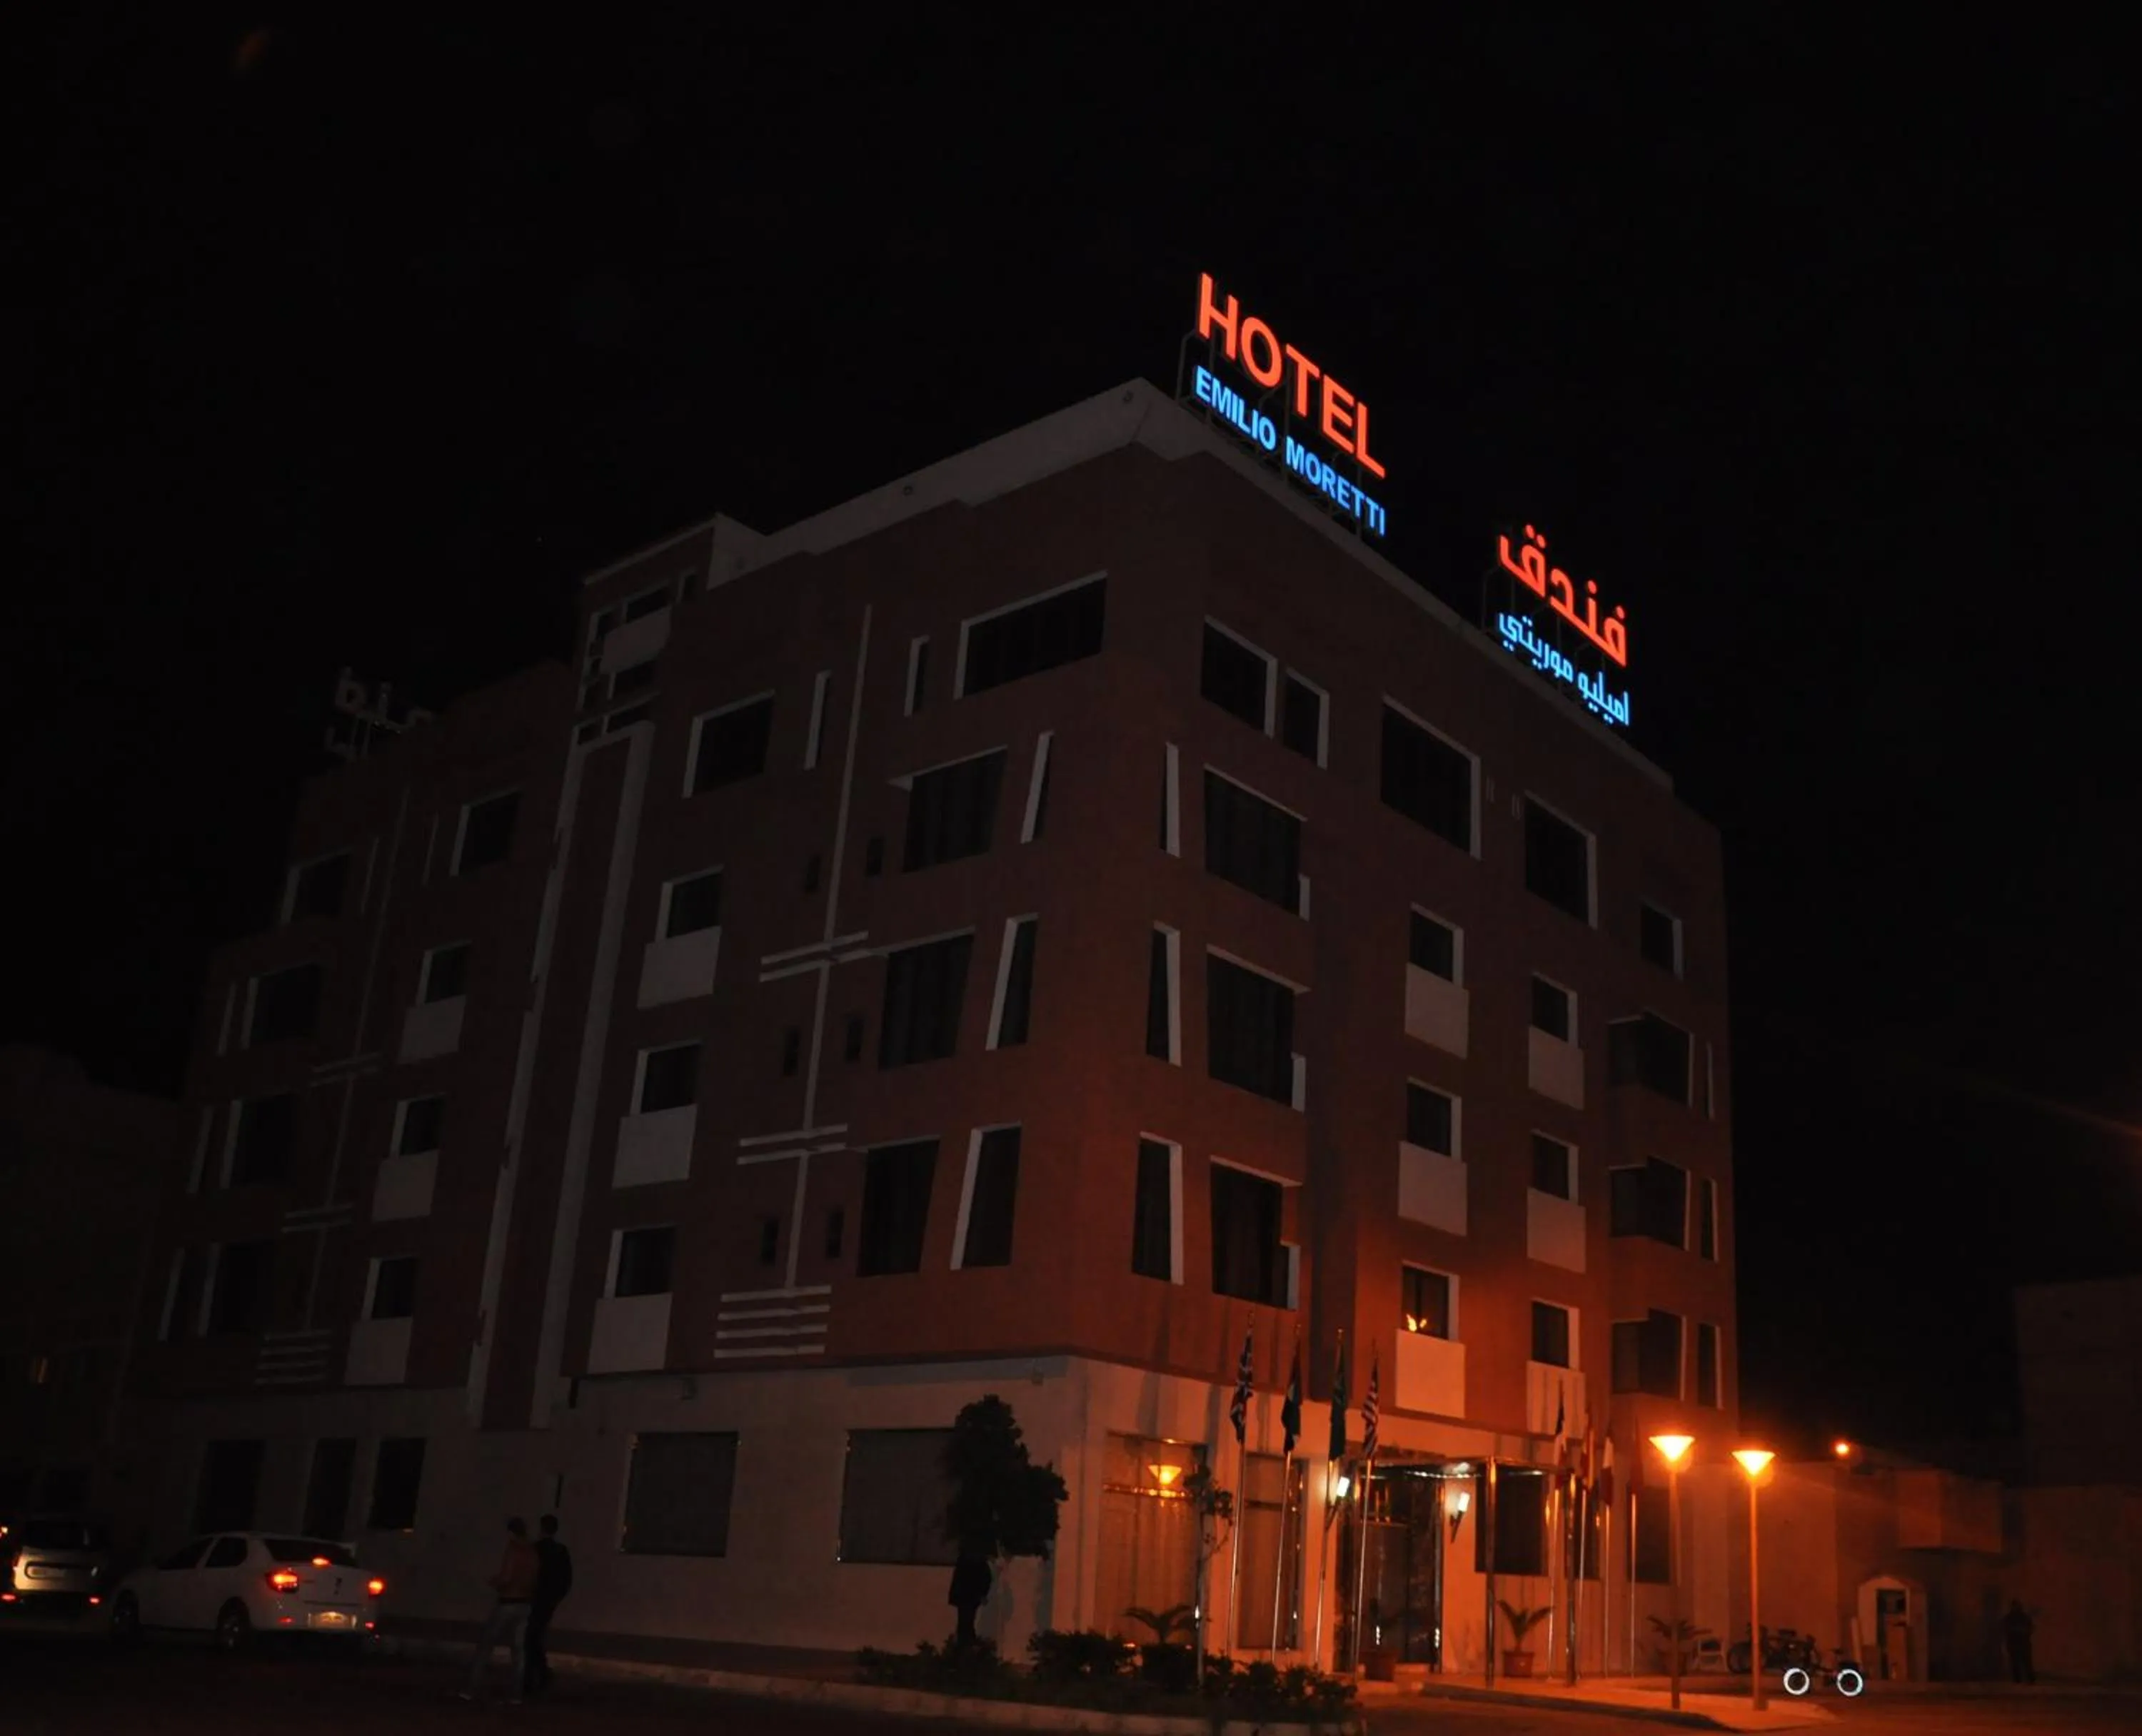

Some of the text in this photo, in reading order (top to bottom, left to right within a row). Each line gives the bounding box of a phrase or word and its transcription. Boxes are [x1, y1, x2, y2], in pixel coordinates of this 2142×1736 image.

[1195, 365, 1385, 536] EMILIO MORETTI
[1199, 273, 1385, 478] HOTEL
[1499, 524, 1627, 667] فندق
[1499, 612, 1574, 684] موريتي
